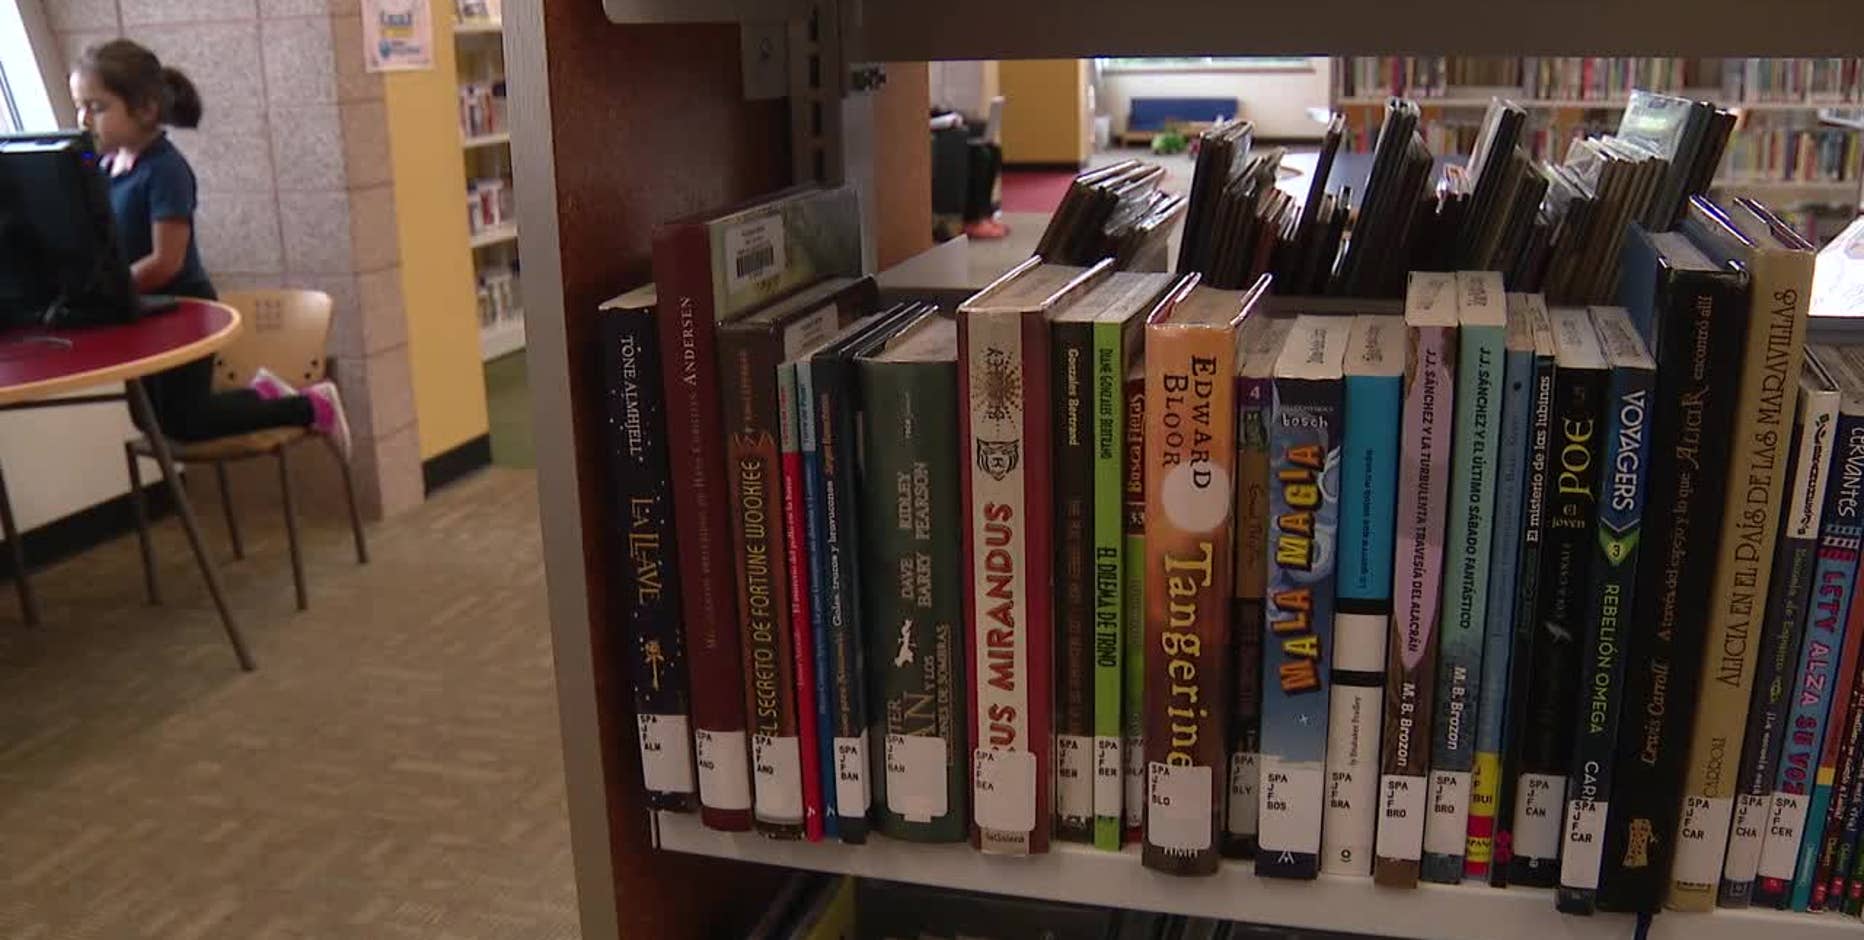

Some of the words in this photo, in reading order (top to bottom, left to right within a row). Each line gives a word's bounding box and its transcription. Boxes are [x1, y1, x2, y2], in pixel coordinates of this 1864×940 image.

[679, 296, 698, 387] ANDERSEN
[1693, 319, 1710, 381] encontró
[618, 335, 637, 381] TONE
[1426, 348, 1437, 368] J.J.
[1479, 347, 1490, 368] J.J.
[1756, 288, 1798, 426] MARAVILLAS
[1249, 386, 1261, 400] 4
[1423, 370, 1438, 424] SÁNCHEZ
[1475, 370, 1492, 429] SÁNCHEZ
[1535, 375, 1551, 426] lubinas
[622, 380, 643, 456] ALMHJELL
[1162, 374, 1189, 467] BLOOR
[1190, 355, 1217, 489] EDWARD
[1282, 412, 1328, 428] bosch
[1422, 427, 1431, 435] Y
[1420, 436, 1432, 451] LA
[1473, 441, 1485, 454] EL
[1474, 430, 1485, 439] Y
[1533, 429, 1547, 450] las
[1531, 452, 1546, 472] de
[1611, 389, 1646, 512] VOYAGERS
[1751, 430, 1777, 470] LAS
[1416, 452, 1431, 524] TURBULENTA
[1469, 456, 1487, 502] ÚLTIMO
[1746, 475, 1772, 505] DE
[630, 496, 654, 528] LA
[739, 460, 766, 539] WOOKIEE
[898, 471, 914, 530] RIDLEY
[915, 462, 930, 541] PEARSON
[1274, 444, 1324, 572] MAGIA
[1528, 474, 1544, 527] misterio
[1466, 505, 1485, 554] SÁBADO
[1526, 530, 1539, 543] El
[1735, 508, 1766, 562] PAÍS
[1413, 527, 1427, 578] TRAVESÍA
[1612, 544, 1620, 557] 3
[628, 532, 662, 606] LLAVE
[745, 545, 769, 616] FORTUNE
[901, 558, 914, 599] DAVE
[916, 551, 931, 608] BARRY
[1734, 567, 1758, 587] EL
[984, 503, 1015, 692] MIRANDUS
[1097, 563, 1118, 608] DILEMA
[1411, 581, 1422, 602] DEL
[1459, 557, 1476, 630] FANTÁSTICO
[1730, 592, 1752, 616] EN
[1815, 571, 1846, 634] LETY
[750, 622, 771, 642] DE
[1097, 611, 1117, 629] DE
[1407, 603, 1421, 652] ALACRÁN
[1597, 584, 1622, 670] REBELIÓN
[1097, 632, 1117, 668] TRINO
[1272, 587, 1322, 696] MALA
[1714, 621, 1750, 688] ALICIA
[1161, 543, 1214, 768] Tangerine
[754, 648, 777, 716] SECRETO
[1453, 666, 1466, 683] M.
[1649, 656, 1670, 716] Carroll
[1799, 640, 1832, 707] ALZA
[1402, 682, 1416, 699] M.
[1451, 686, 1465, 700] B.
[1588, 672, 1609, 735] OMEGA
[1400, 702, 1414, 717] B.
[1447, 702, 1463, 750] Brozon
[1793, 715, 1818, 747] SU
[838, 745, 858, 755] SPA
[1059, 739, 1078, 749] SPA
[1098, 739, 1118, 750] SPA
[1396, 718, 1412, 767] Brozon
[1151, 764, 1170, 775] SPA
[1234, 755, 1254, 766] SPA
[1702, 738, 1726, 800] CARROLL
[1784, 752, 1814, 796] VOZ
[840, 772, 859, 781] BAN
[1232, 785, 1252, 795] BLY
[1267, 773, 1288, 783] SPA
[1332, 772, 1352, 782] SPA
[1388, 781, 1408, 791] SPA
[1436, 776, 1457, 786] SPA
[1529, 779, 1549, 789] SPA
[1580, 760, 1600, 800] CAR
[1266, 801, 1287, 811] BOS
[1330, 800, 1351, 809] BRA
[1386, 808, 1407, 818] BRO
[1434, 804, 1455, 814] BRO
[1526, 807, 1546, 817] CAN
[1574, 801, 1596, 812] SPA
[1687, 798, 1709, 809] SPA
[1740, 796, 1762, 807] SPA
[1775, 797, 1797, 809] SPA
[1570, 832, 1592, 843] CAR
[1682, 828, 1705, 839] CAR
[1735, 827, 1757, 838] CHA
[1771, 826, 1793, 838] CER
